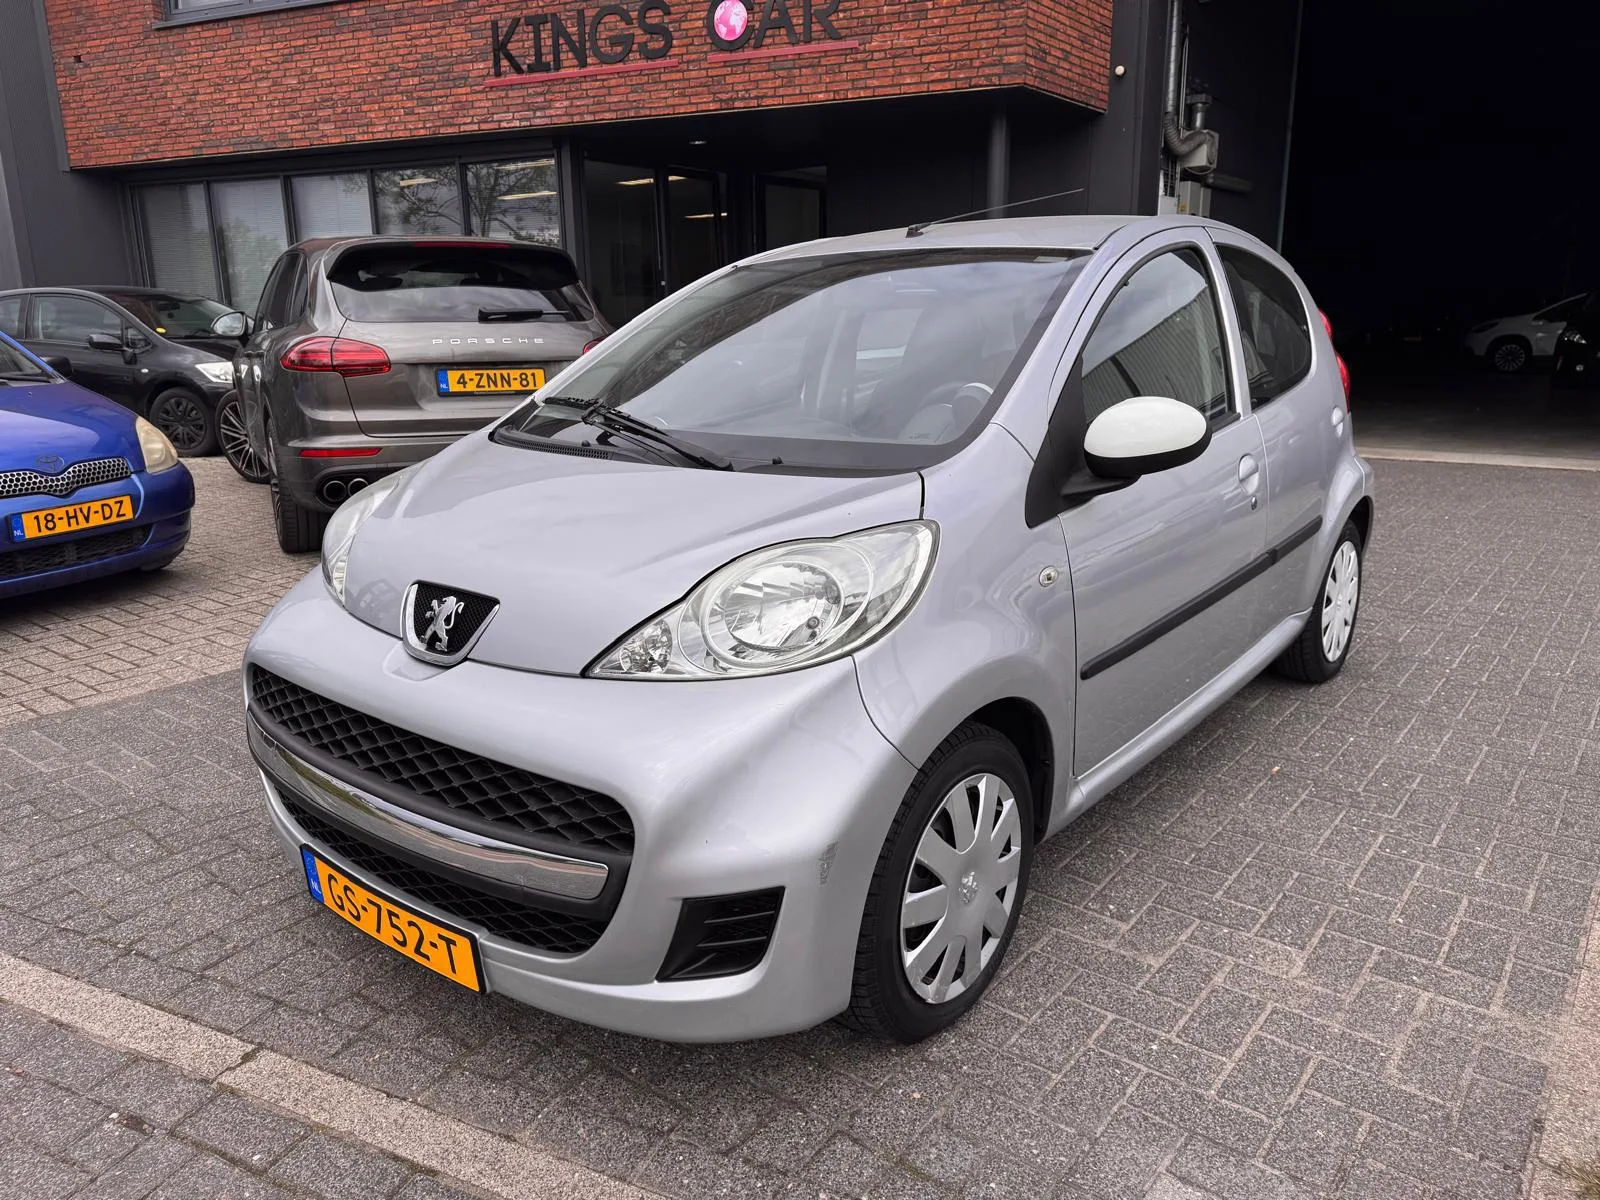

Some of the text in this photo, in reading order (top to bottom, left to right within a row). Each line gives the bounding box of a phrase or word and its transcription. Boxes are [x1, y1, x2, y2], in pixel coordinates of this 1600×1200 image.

[491, 0, 842, 77] KINGS CAR
[456, 373, 537, 388] 4-ZNN-81
[33, 500, 126, 533] 18-HV-DZ
[328, 873, 456, 974] GS-752-T
